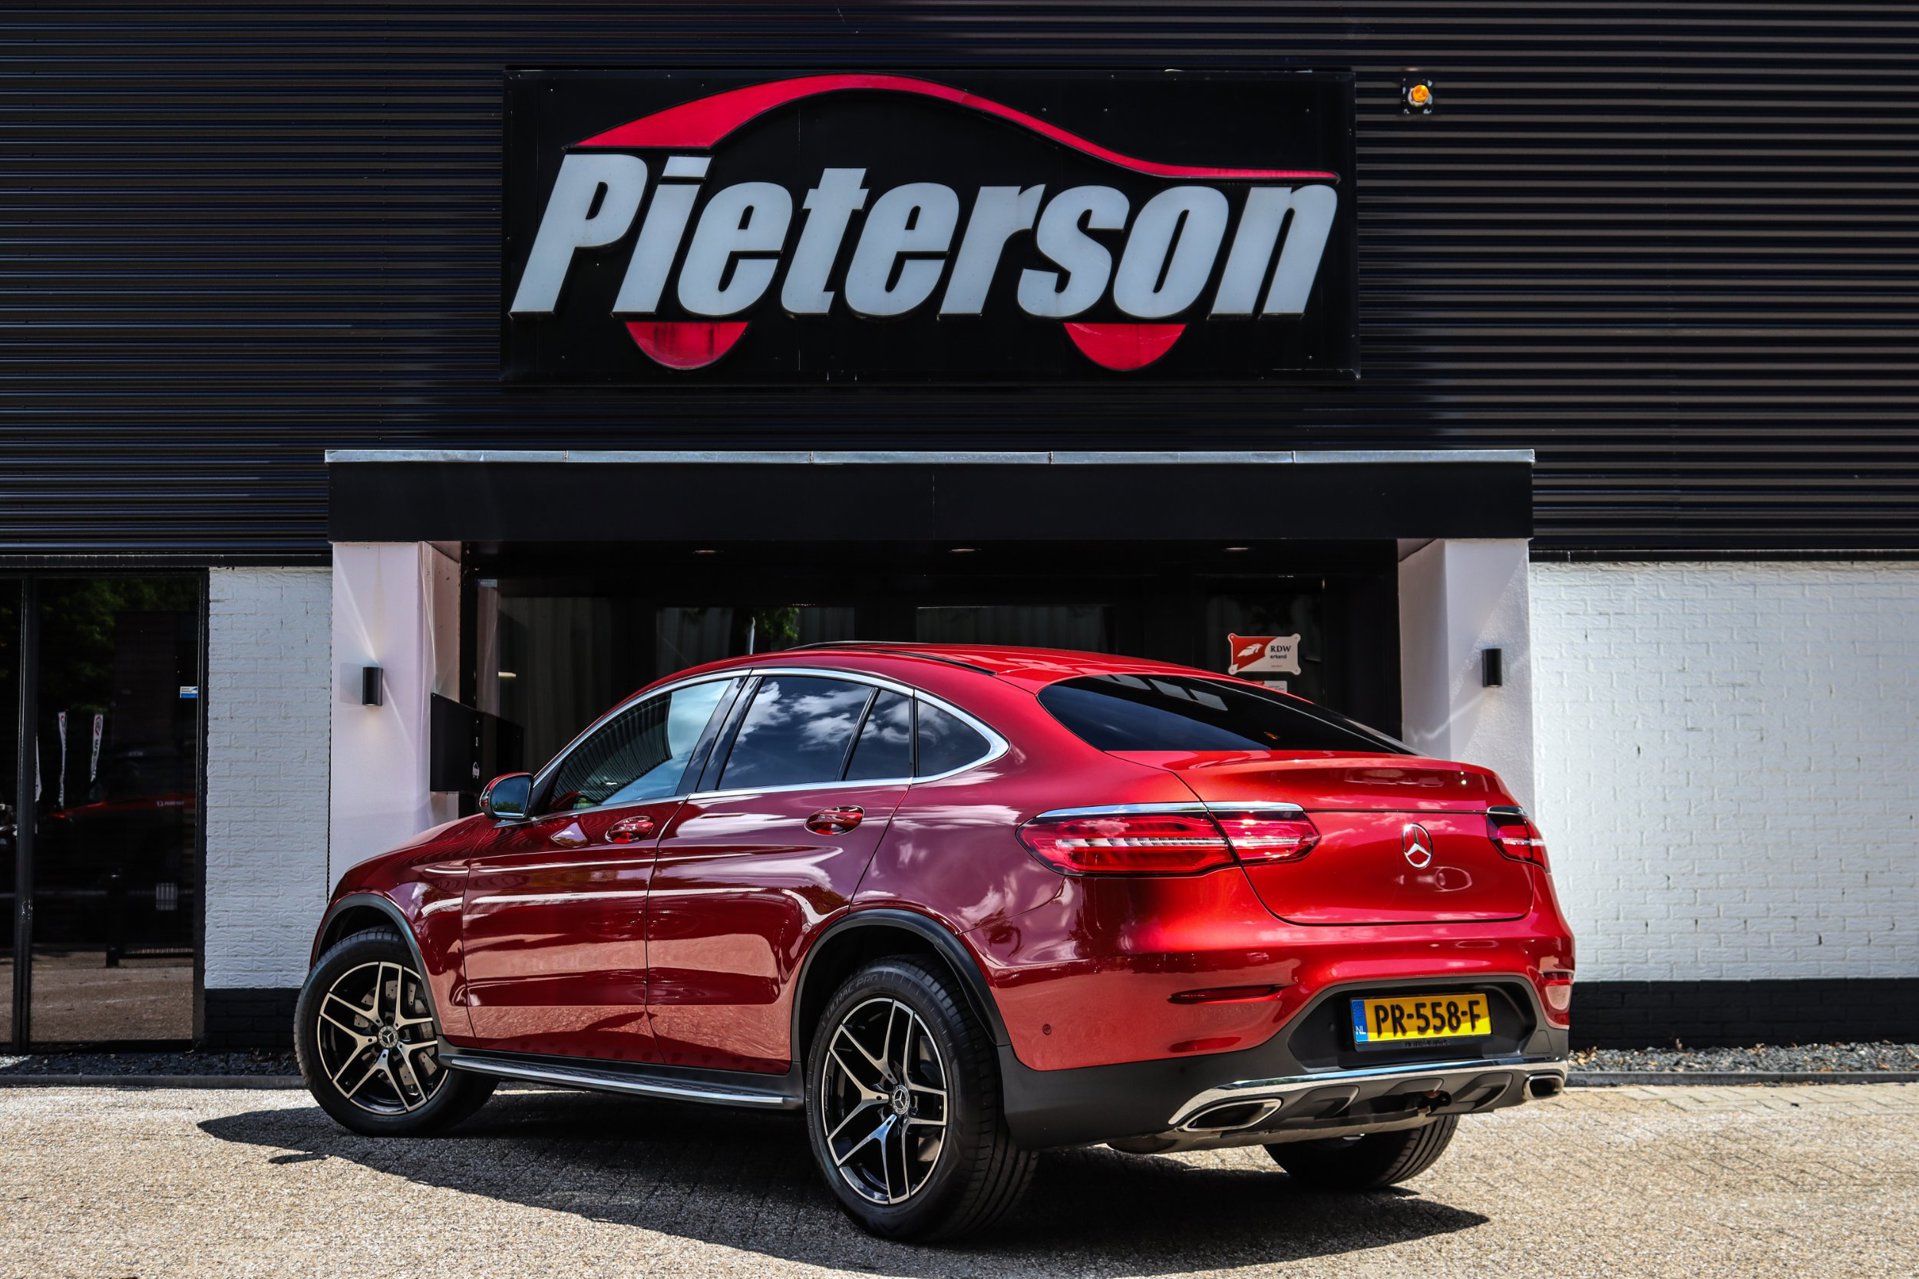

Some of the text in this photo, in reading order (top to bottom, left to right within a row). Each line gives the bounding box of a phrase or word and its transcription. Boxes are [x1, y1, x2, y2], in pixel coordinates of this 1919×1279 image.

[508, 153, 1338, 319] Pieterson
[1355, 1026, 1367, 1035] NL
[1374, 1000, 1481, 1038] PR-558-F
